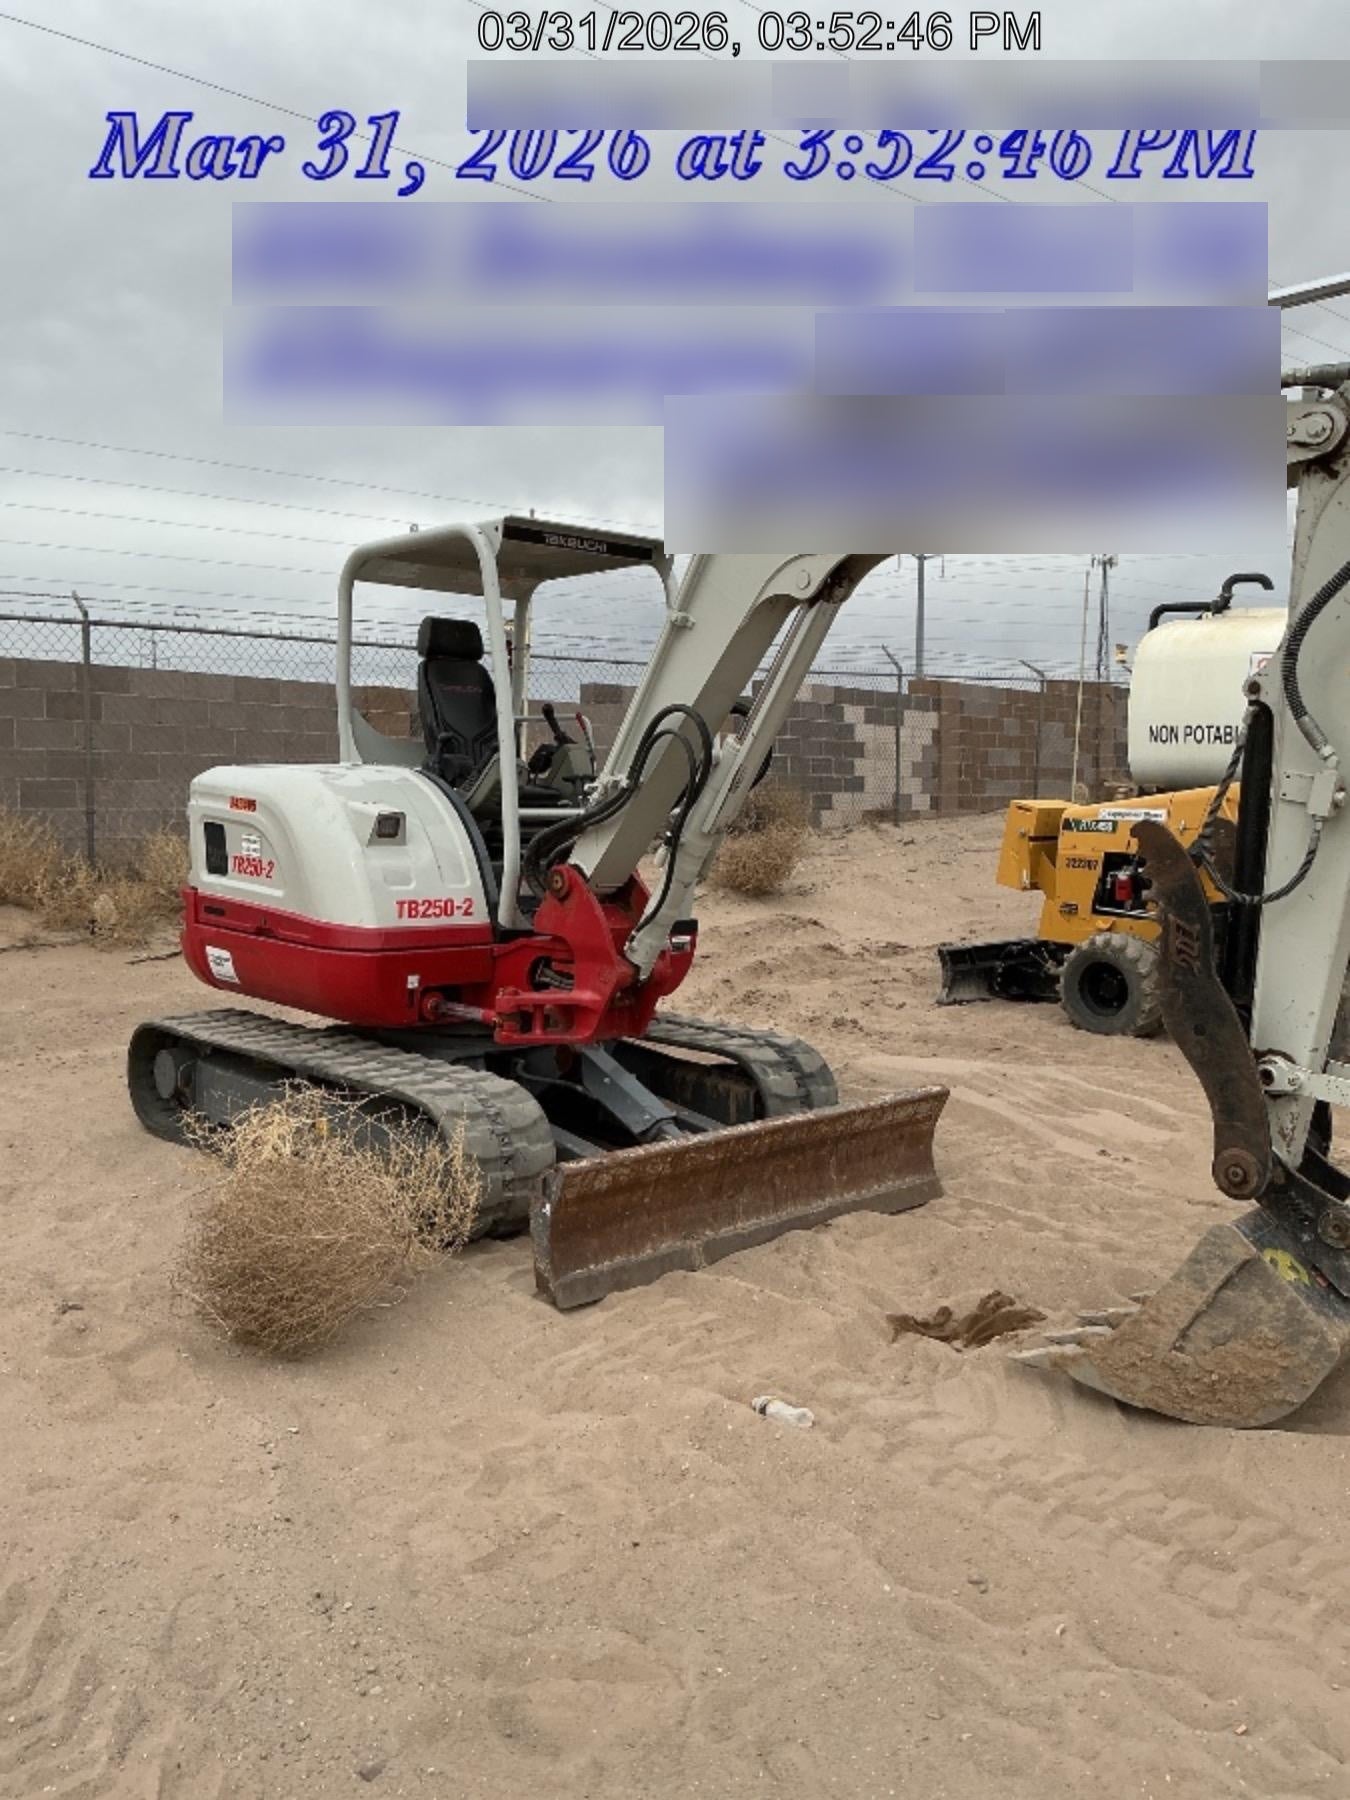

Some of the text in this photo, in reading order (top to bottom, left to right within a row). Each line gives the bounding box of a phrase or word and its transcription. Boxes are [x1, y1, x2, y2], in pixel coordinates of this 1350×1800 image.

[1148, 725, 1179, 744] NON
[232, 855, 275, 879] TB250-2
[395, 897, 474, 919] TB250-2
